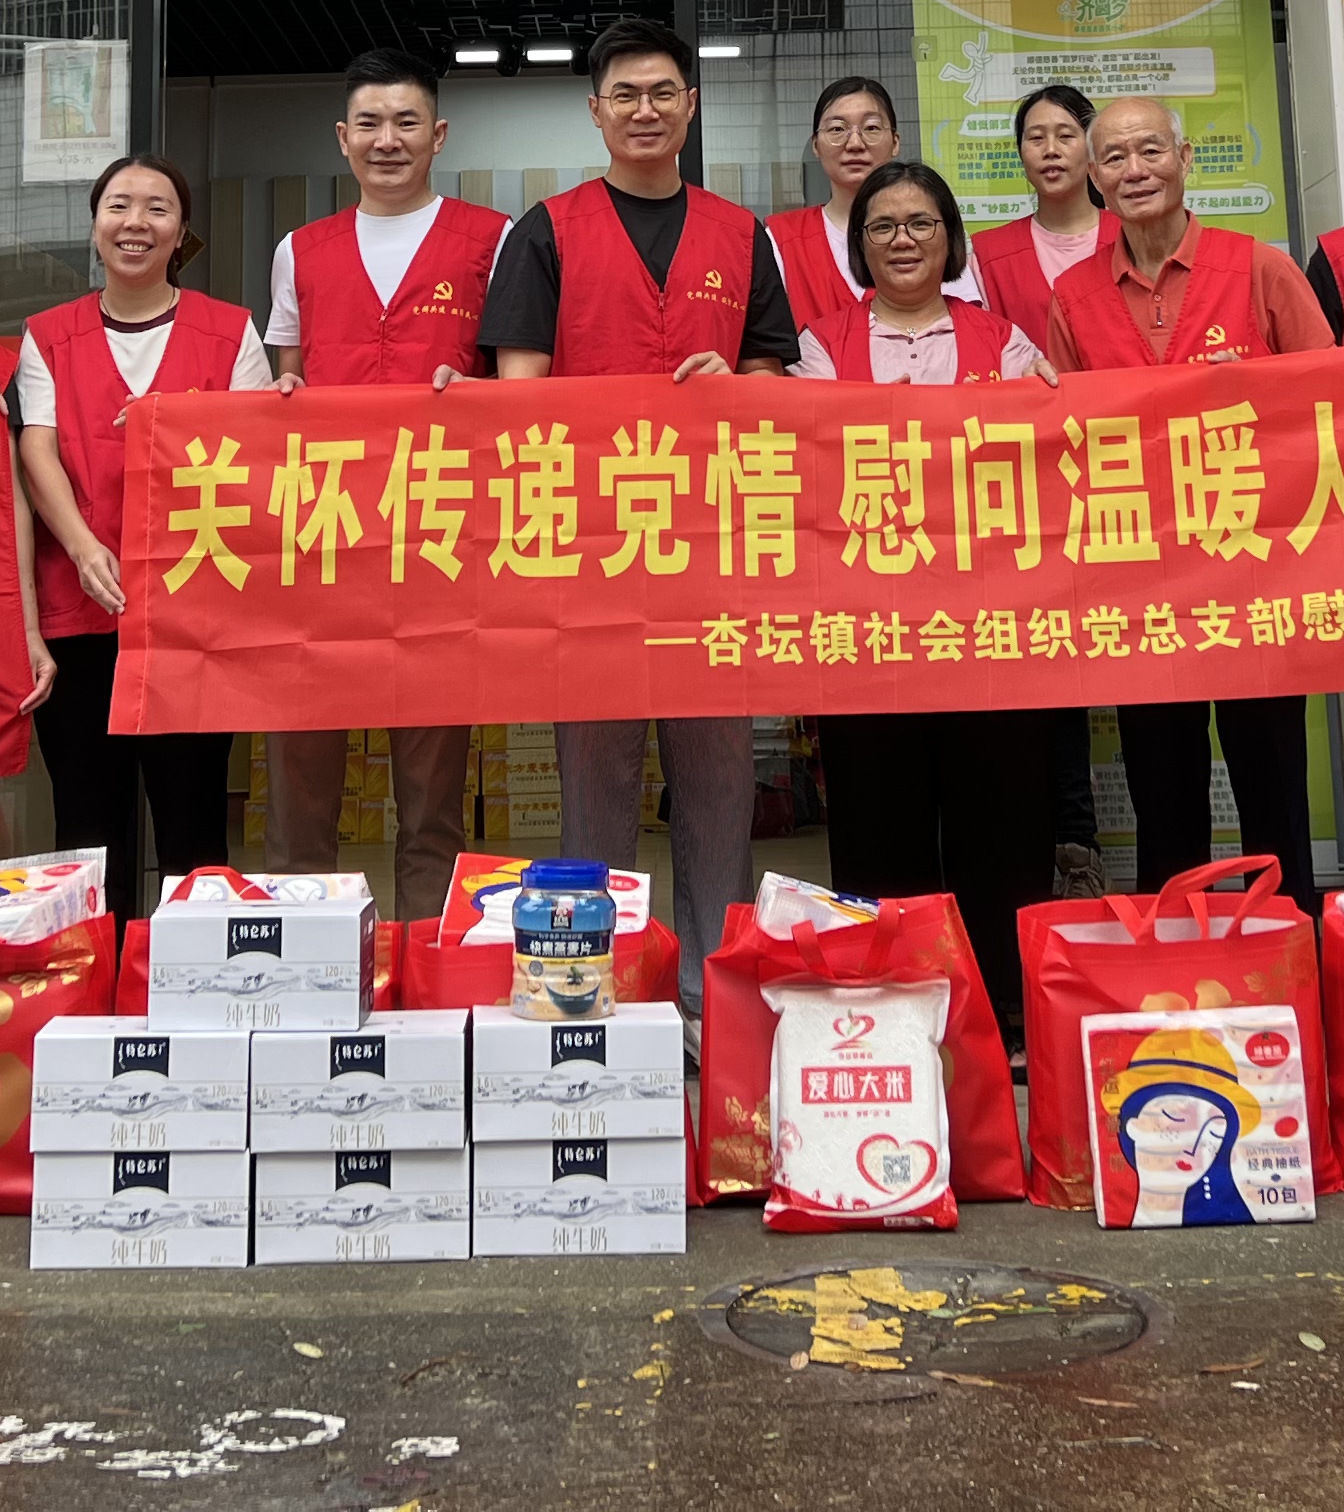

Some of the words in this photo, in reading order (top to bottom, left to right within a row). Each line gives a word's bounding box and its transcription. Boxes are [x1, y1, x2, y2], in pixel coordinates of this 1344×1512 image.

[162, 419, 802, 595] 关怀传递党情
[529, 941, 592, 956] 快煮燕麦片
[226, 1002, 281, 1028] 纯牛奶
[807, 1071, 906, 1100] 爱心大米
[110, 1121, 167, 1149] 纯牛奶
[329, 1122, 385, 1149] 纯牛奶
[551, 1110, 607, 1137] 纯牛奶
[111, 1238, 168, 1266] 纯牛奶
[335, 1233, 391, 1261] 纯牛奶
[552, 1226, 608, 1253] 纯牛奶
